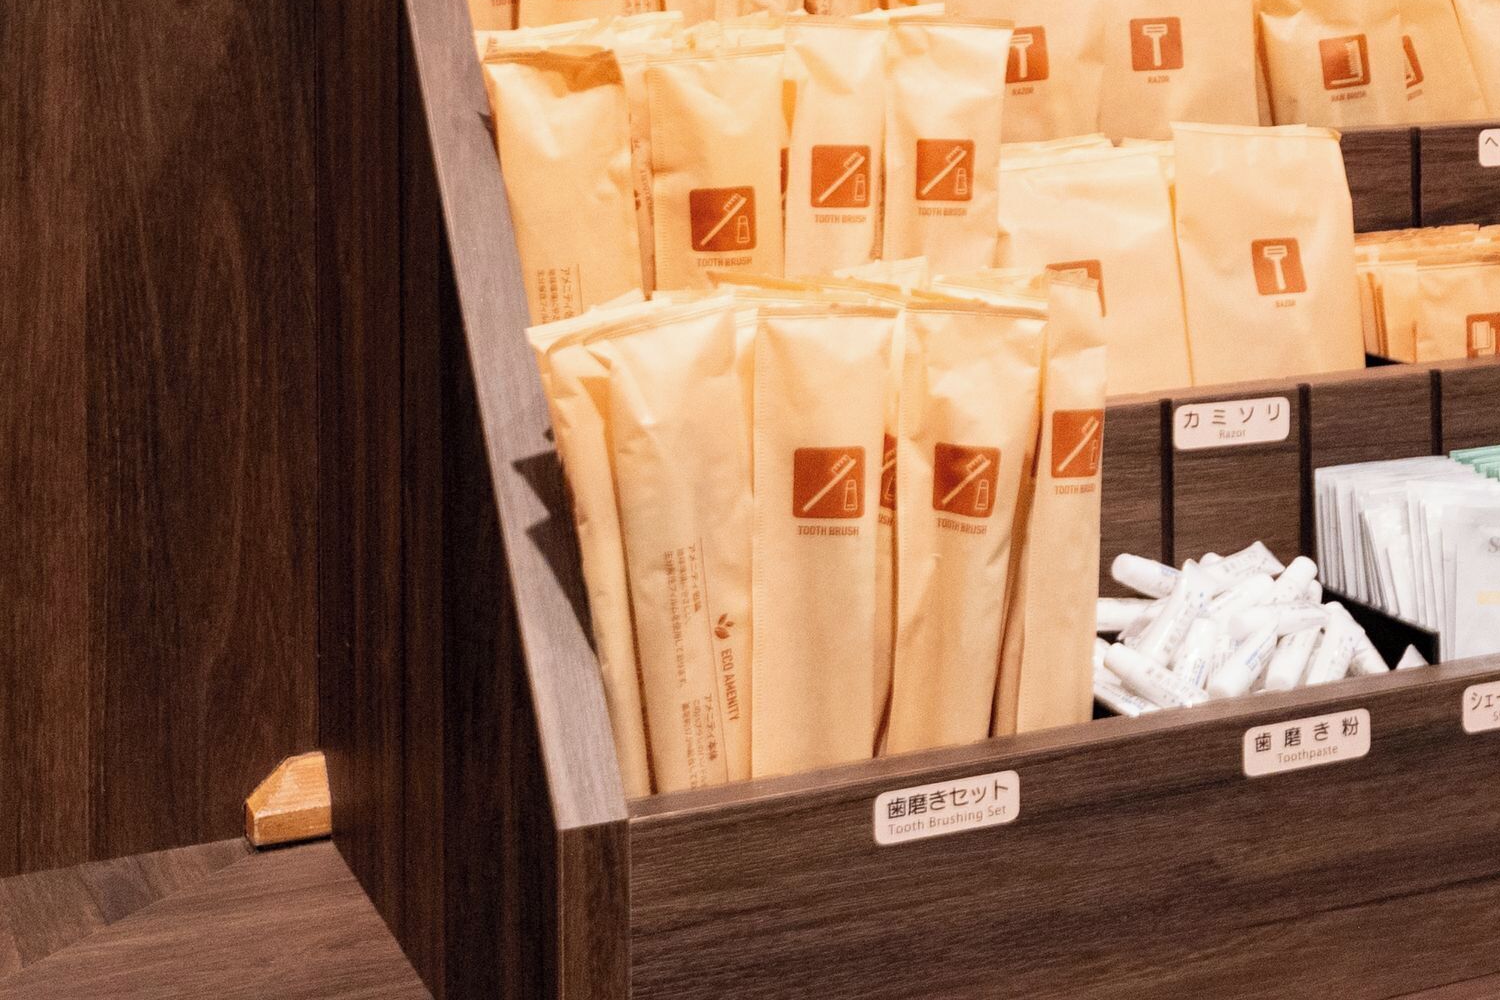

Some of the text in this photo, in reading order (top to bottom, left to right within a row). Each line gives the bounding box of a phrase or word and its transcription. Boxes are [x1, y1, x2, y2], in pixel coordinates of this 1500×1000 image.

[1184, 403, 1280, 429] カミソリ
[1219, 429, 1246, 439] Razor
[798, 525, 859, 537] TOOTH BRUSH
[937, 518, 987, 535] TOOTH BRUSH
[721, 648, 741, 721] ECO AMENITY
[1255, 716, 1359, 752] 歯磨き粉
[1277, 745, 1338, 763] Toothpaste
[887, 779, 1008, 820] 歯磨きセット
[888, 804, 1007, 836] Tooth Brushing Set
